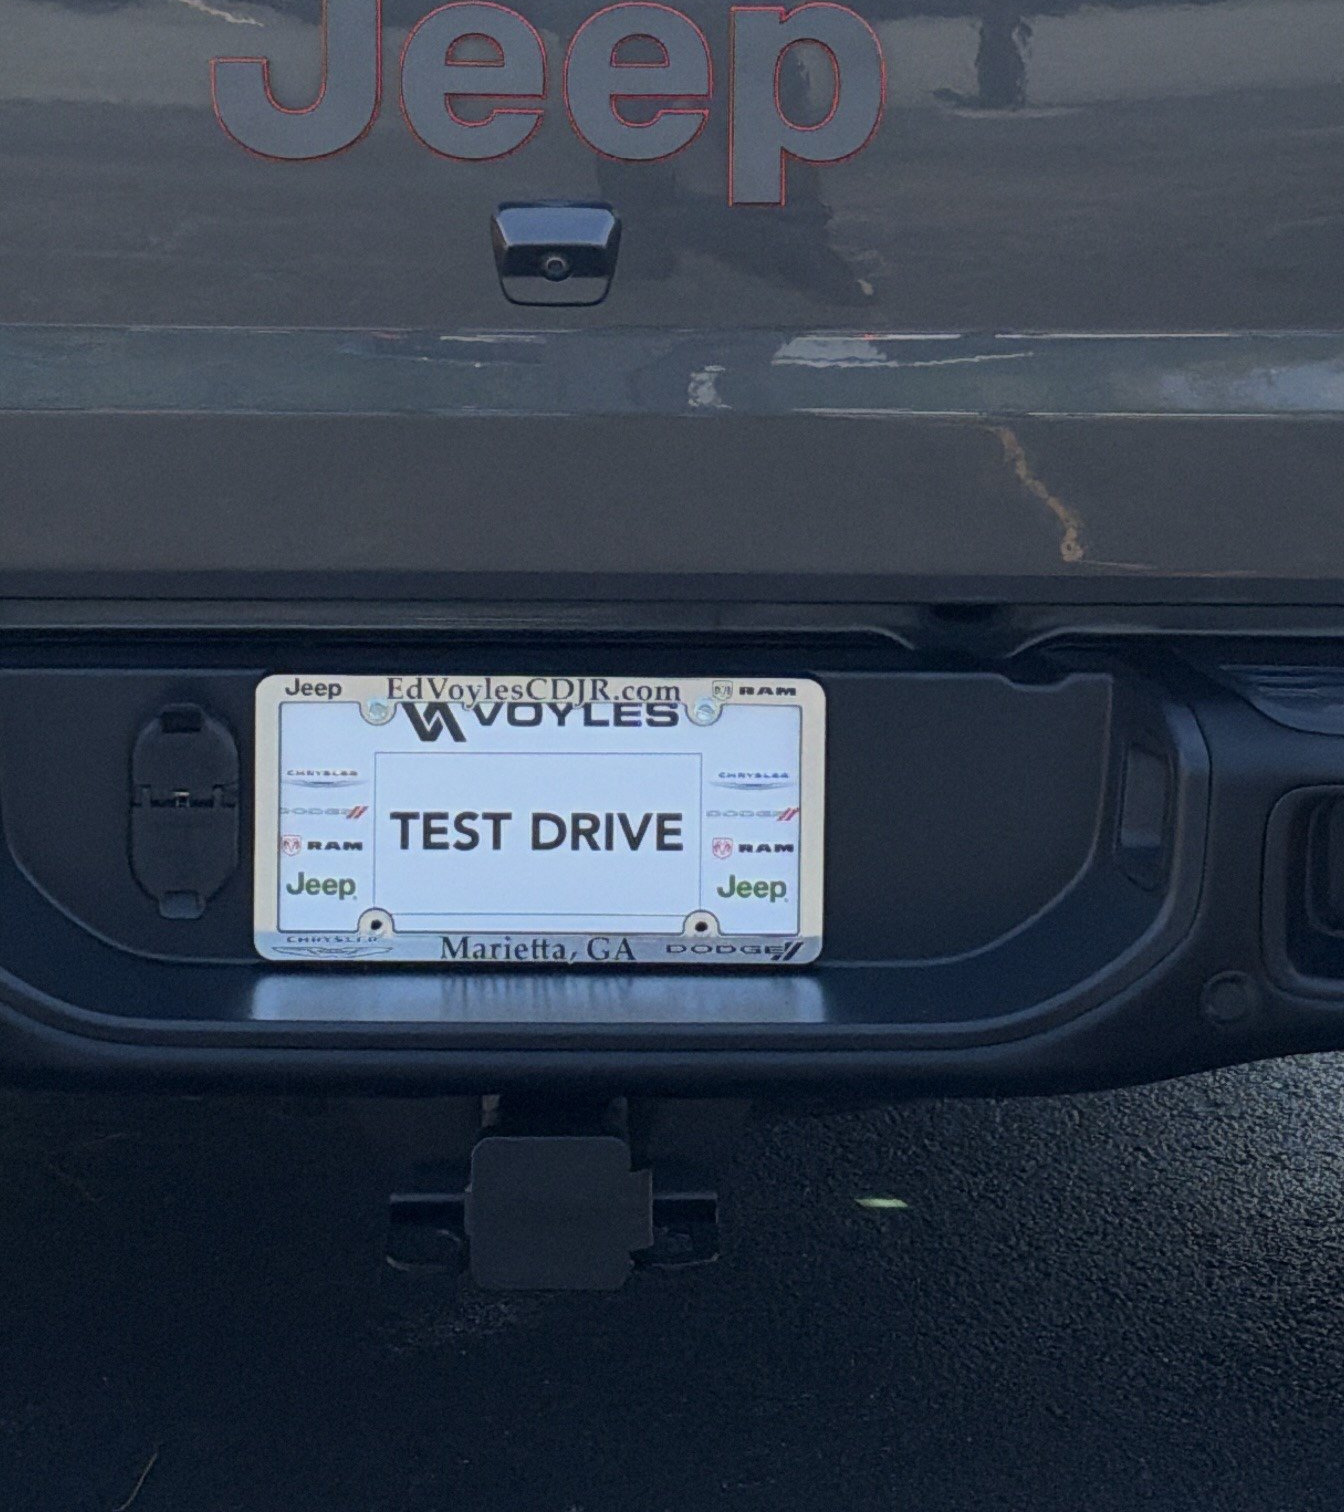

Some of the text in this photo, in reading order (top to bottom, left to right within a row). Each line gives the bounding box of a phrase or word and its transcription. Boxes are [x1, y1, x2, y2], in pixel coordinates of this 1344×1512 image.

[285, 678, 342, 700] Jeep
[387, 677, 681, 709] EdVoylesCDJR.com
[739, 686, 797, 696] RAM
[473, 702, 679, 727] VOYLES
[390, 811, 683, 851] TEST DRIVE
[307, 841, 363, 851] RAM
[738, 843, 794, 853] RAM
[286, 872, 356, 900] Jeep
[717, 874, 786, 903] Jeep
[440, 936, 636, 961] Marietta, GA
[666, 943, 785, 954] DODGE
